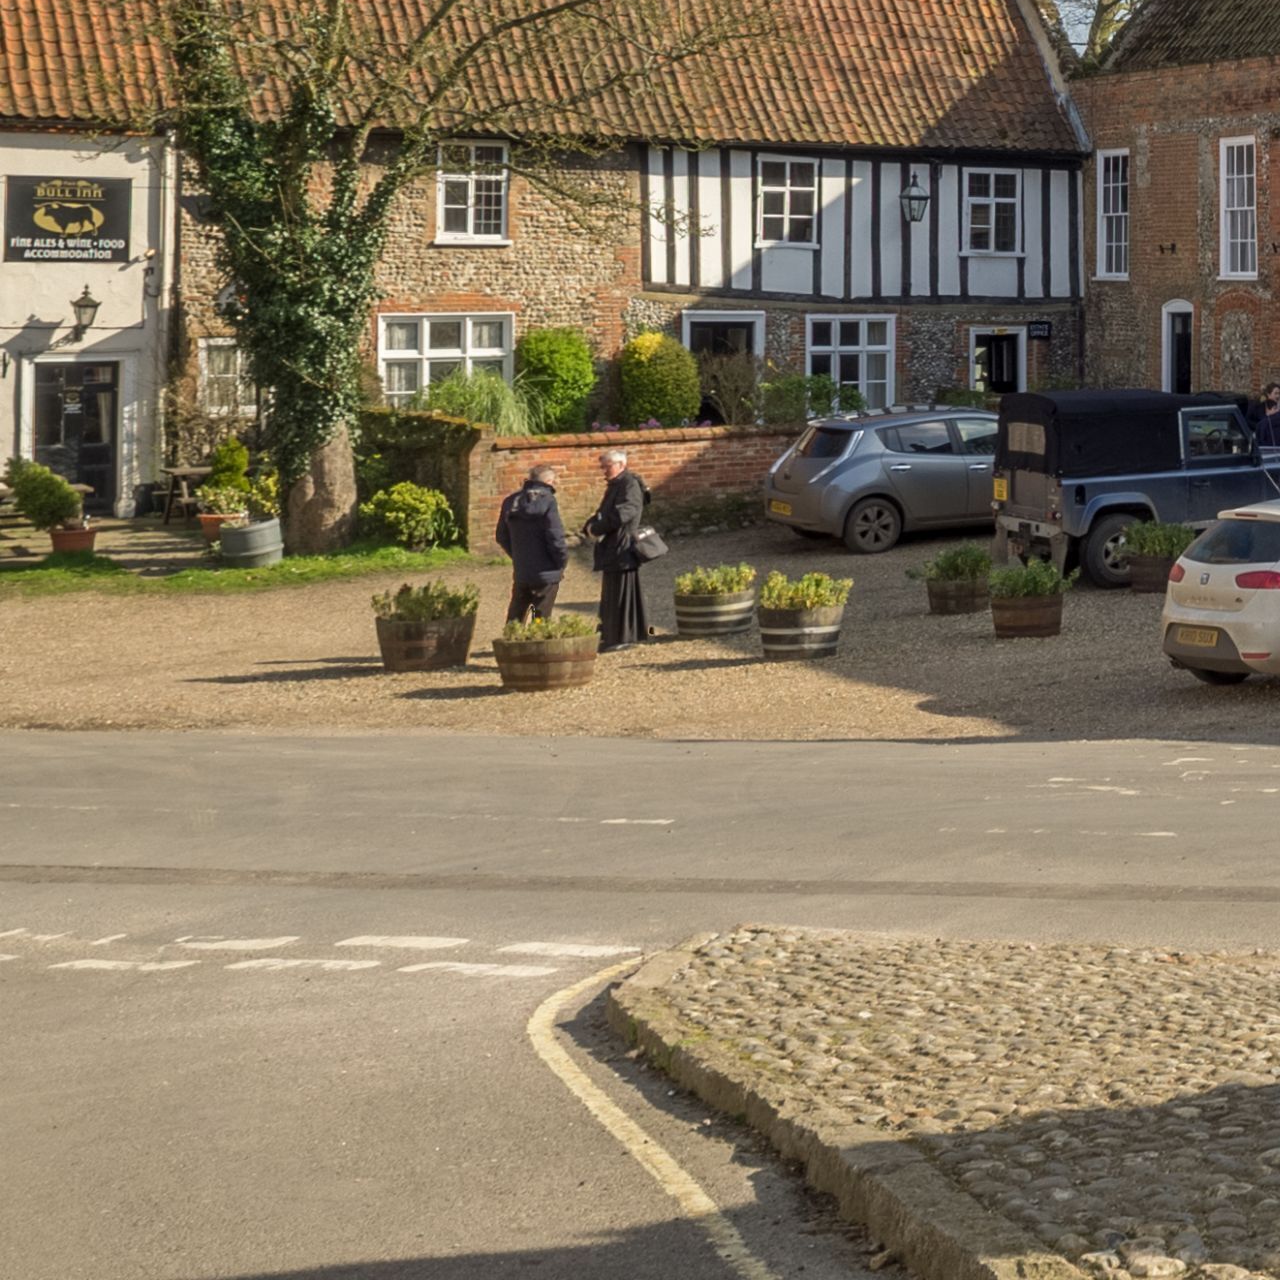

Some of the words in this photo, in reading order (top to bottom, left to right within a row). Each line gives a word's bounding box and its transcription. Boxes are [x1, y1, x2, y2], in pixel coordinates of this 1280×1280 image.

[34, 238, 57, 248] ALES
[58, 238, 65, 249] &
[98, 239, 125, 249] FOOD
[24, 248, 112, 259] ACCOMMODATION
